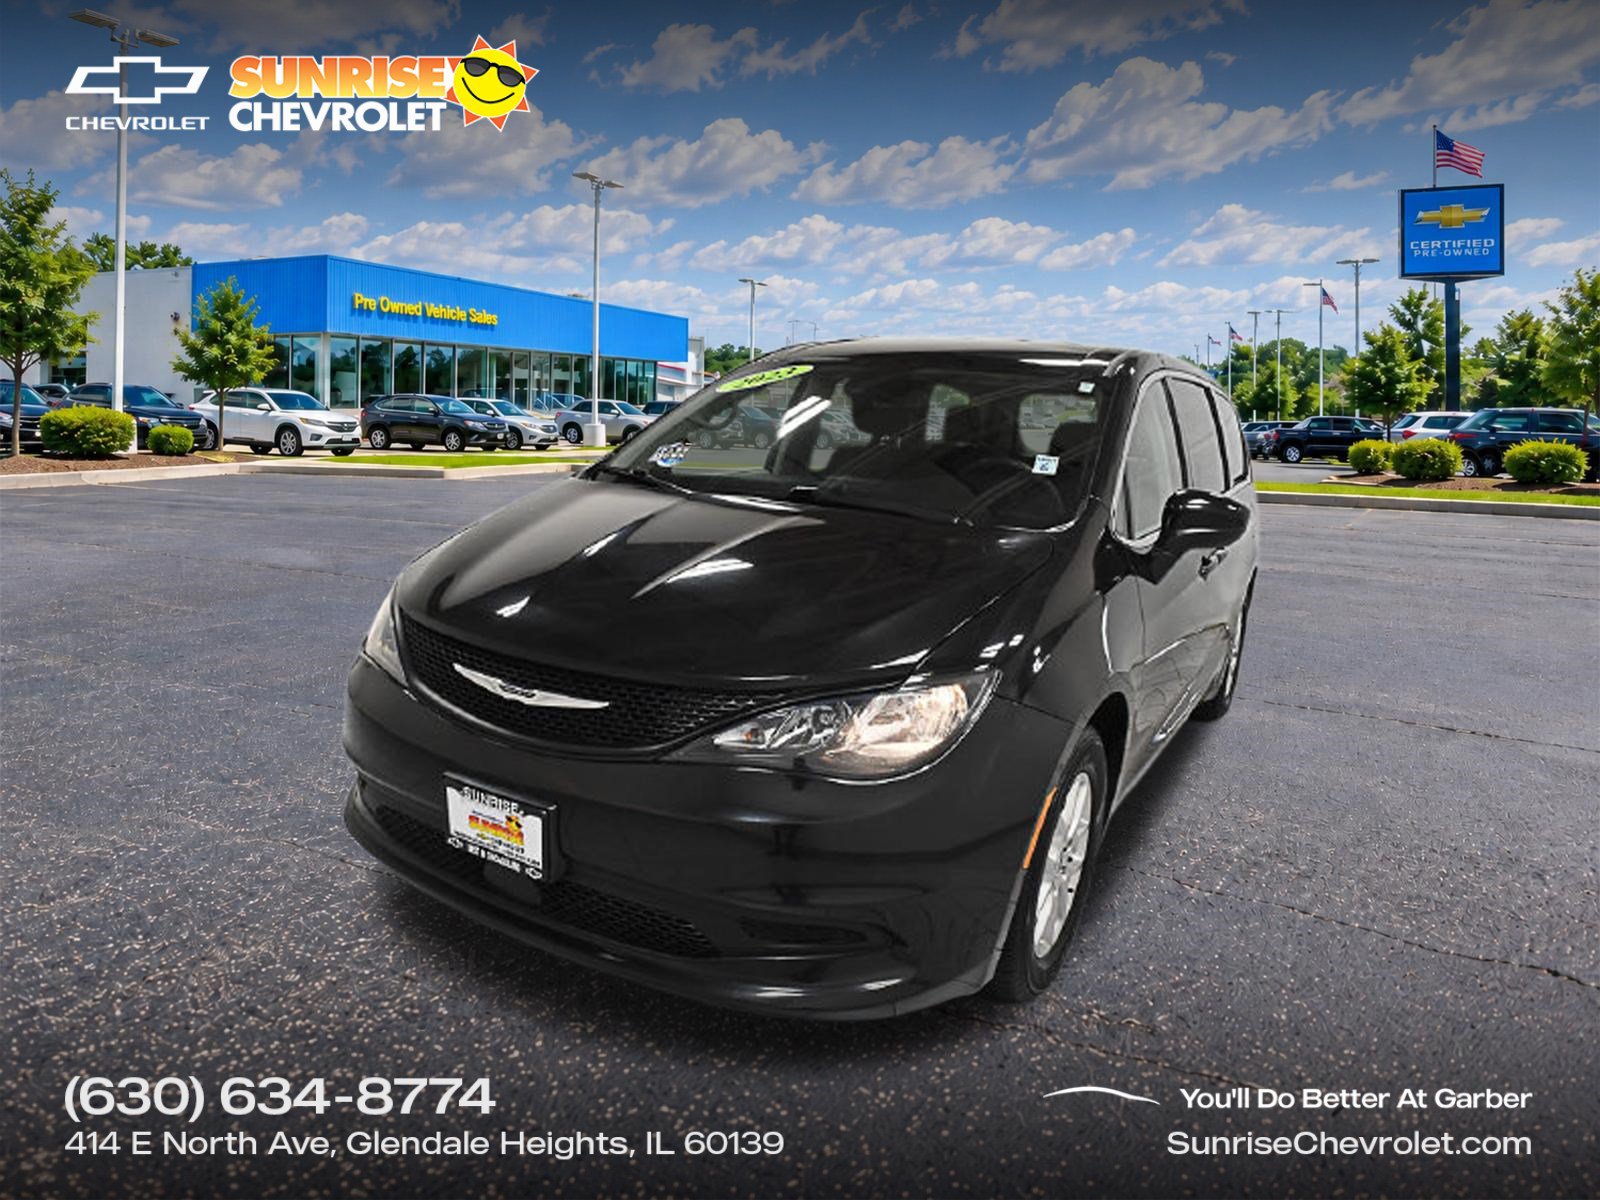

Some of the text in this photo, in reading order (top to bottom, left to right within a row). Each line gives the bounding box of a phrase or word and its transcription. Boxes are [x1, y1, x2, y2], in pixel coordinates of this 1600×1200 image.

[1410, 239, 1495, 250] CERTIFIED
[1413, 248, 1490, 257] PRE-OWNED
[353, 293, 498, 325] Pre Owned Vehicle Sales
